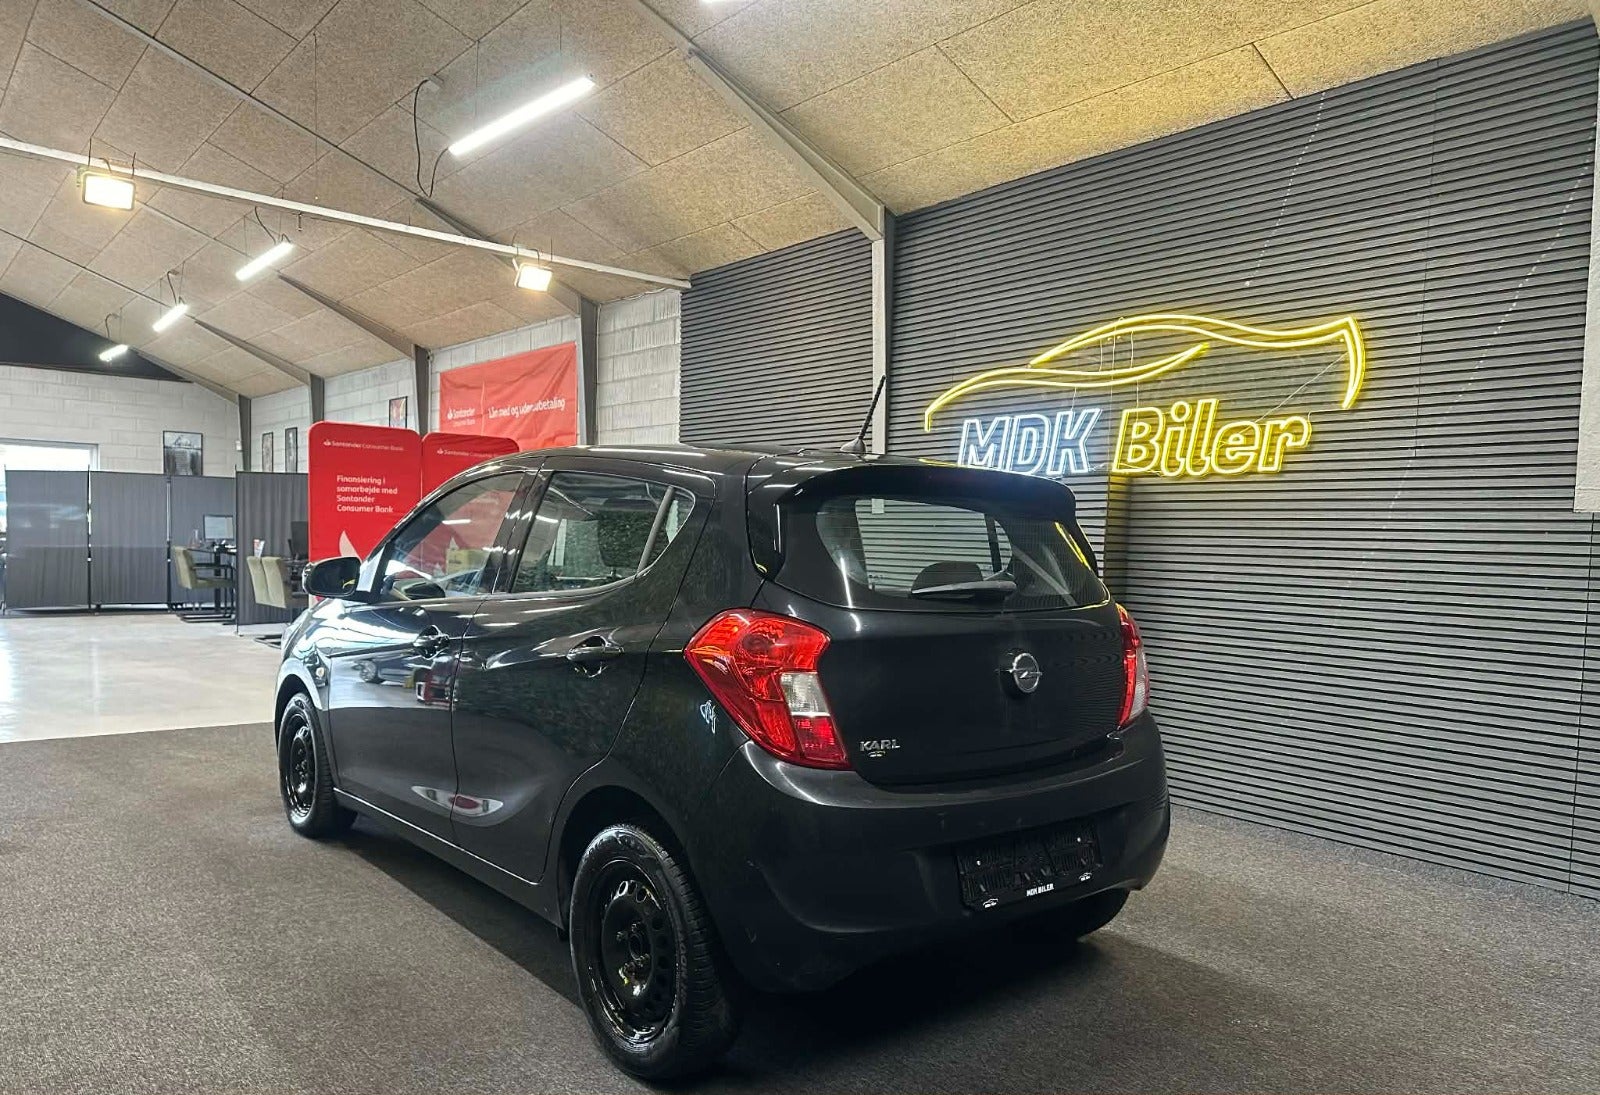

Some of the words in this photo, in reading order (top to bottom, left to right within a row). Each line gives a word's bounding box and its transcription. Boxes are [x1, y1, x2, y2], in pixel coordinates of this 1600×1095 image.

[957, 408, 1103, 475] MDK
[1111, 398, 1311, 477] Biler
[336, 475, 382, 485] Finansiering
[336, 486, 381, 495] samarbejde
[336, 495, 375, 503] Santander
[860, 739, 901, 752] KARL
